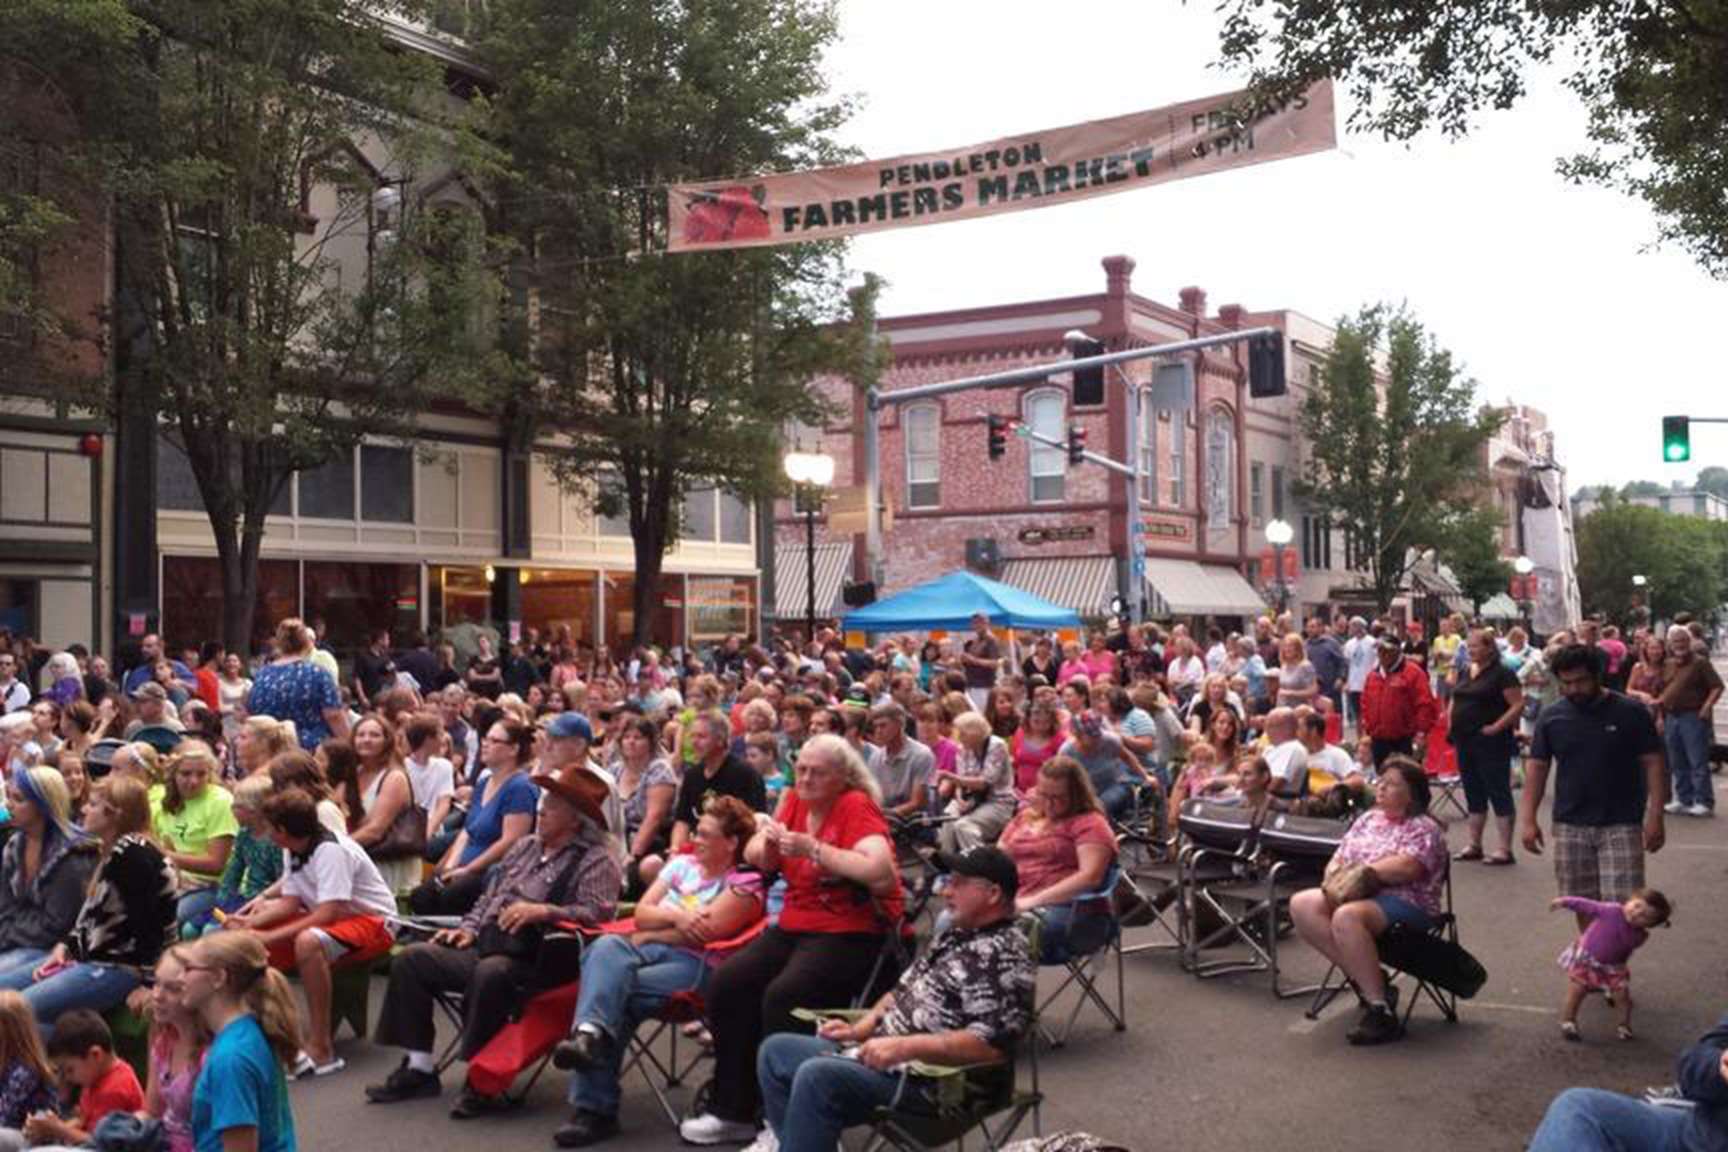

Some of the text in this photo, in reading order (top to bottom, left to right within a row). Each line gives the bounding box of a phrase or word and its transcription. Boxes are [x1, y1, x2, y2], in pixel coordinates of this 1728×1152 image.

[1192, 94, 1309, 132] FRAYS
[1215, 125, 1255, 157] PM
[879, 142, 1042, 188] PENDLETON
[782, 147, 1154, 233] FARMERS MARKET
